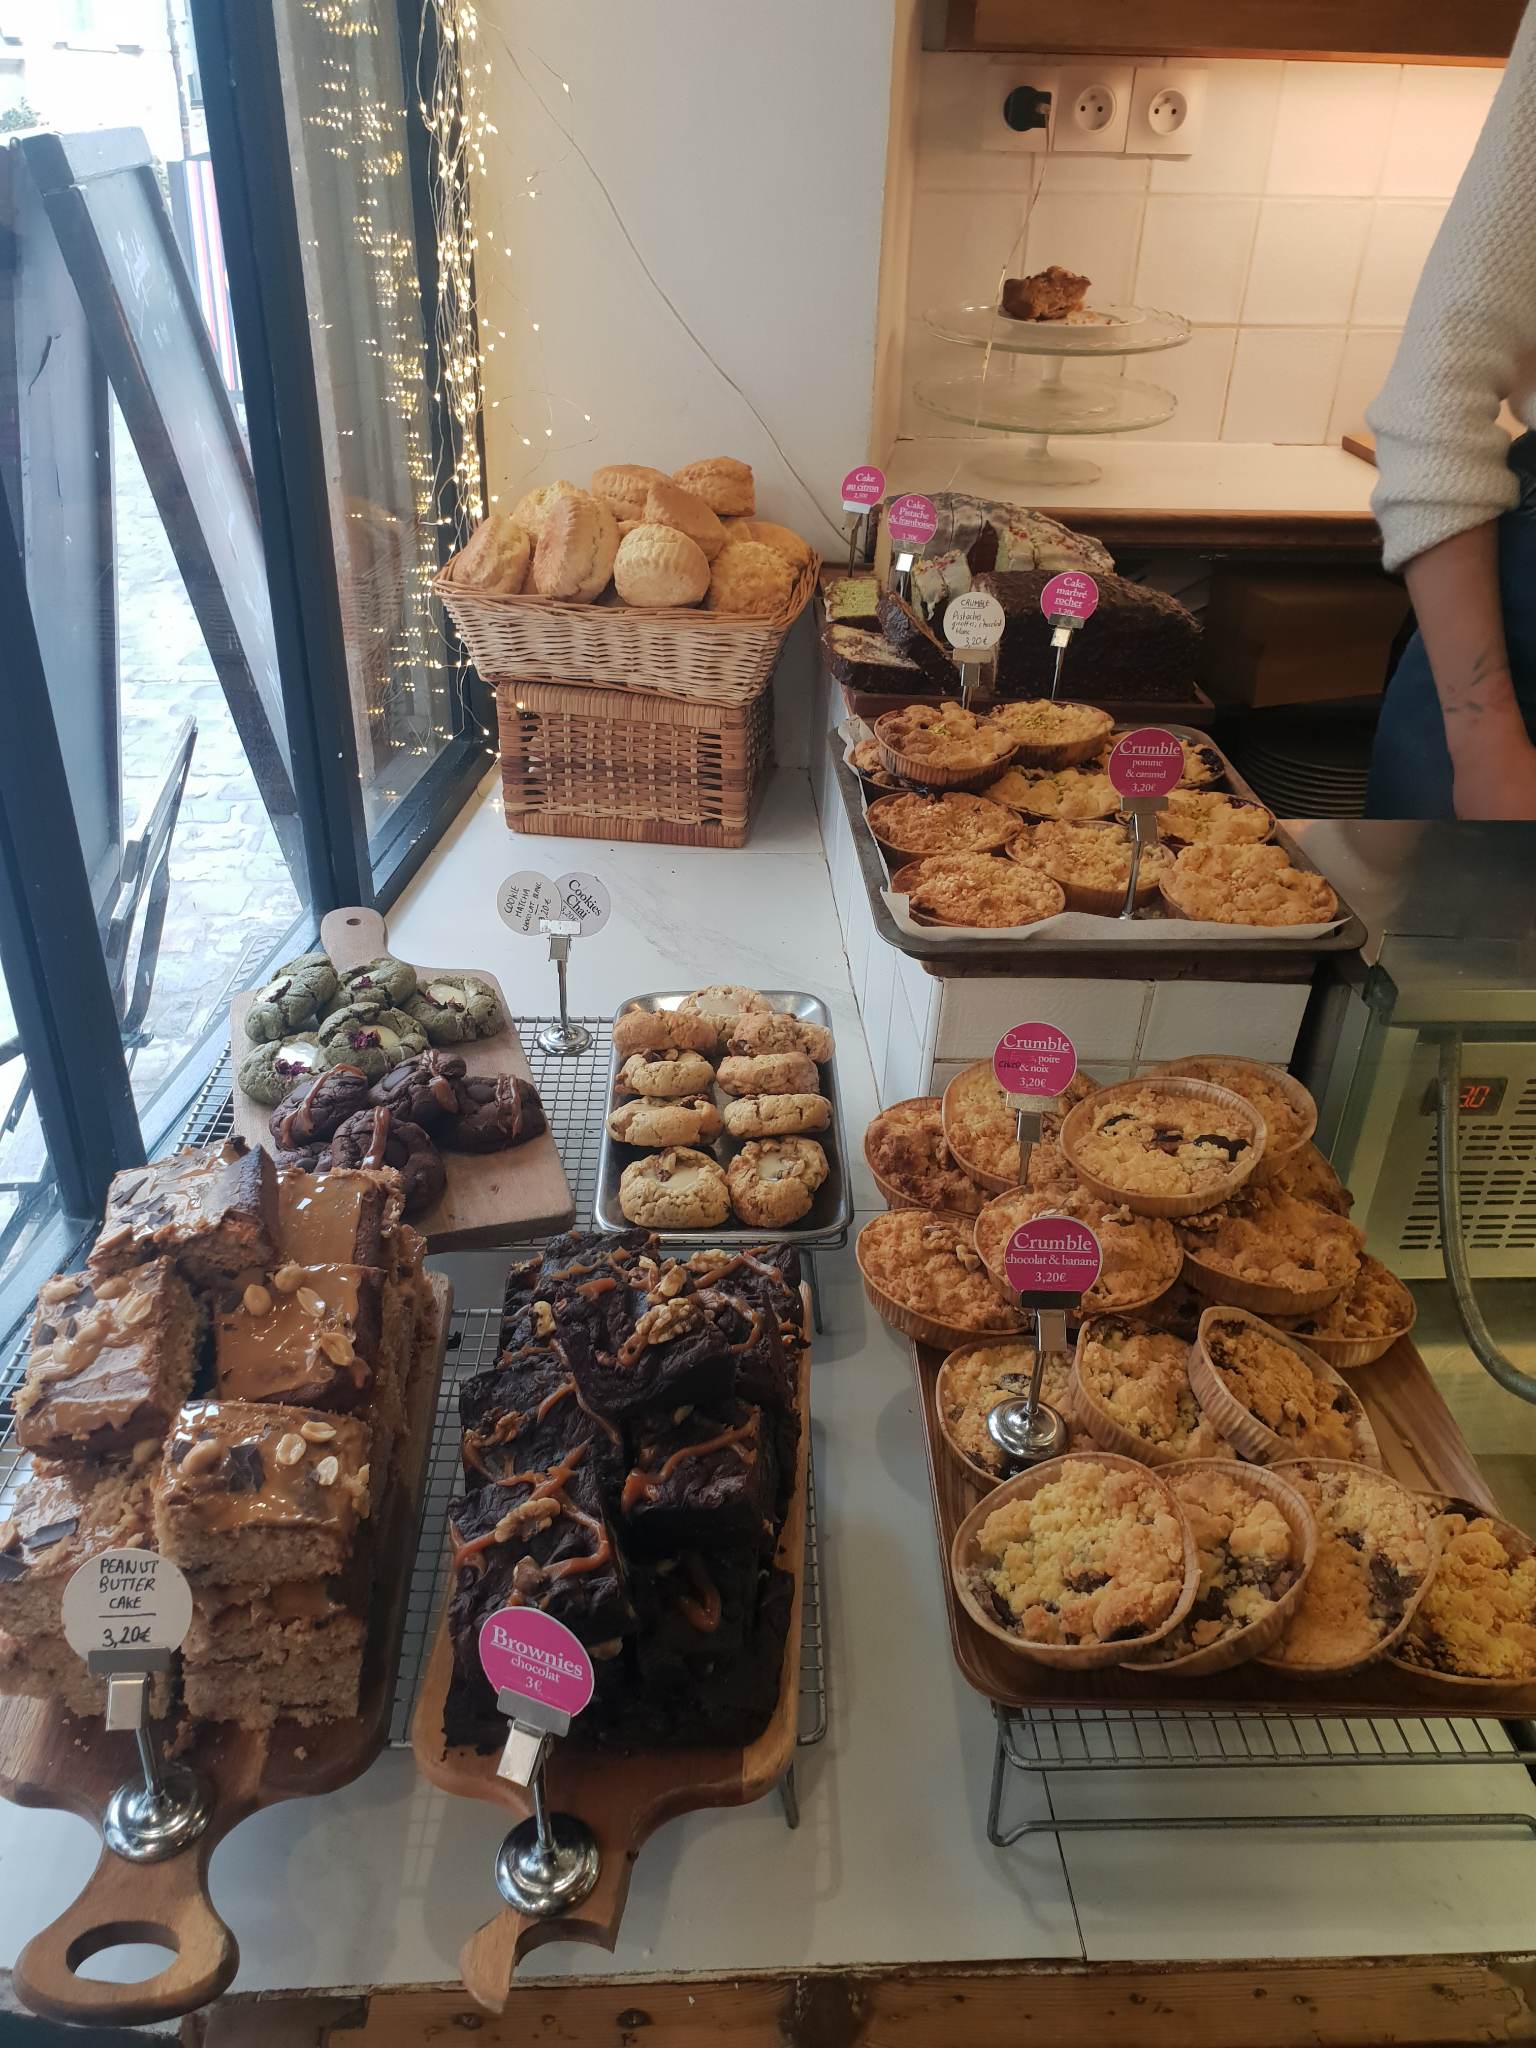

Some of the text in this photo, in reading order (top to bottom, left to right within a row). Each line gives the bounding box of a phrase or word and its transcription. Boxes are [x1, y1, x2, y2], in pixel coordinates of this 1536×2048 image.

[856, 473, 876, 483] Cake
[906, 500, 926, 510] Cake
[899, 507, 930, 519] Pistache
[889, 515, 898, 524] &
[1063, 577, 1086, 589] Cake
[1056, 587, 1088, 598] marbré
[1054, 596, 1084, 608] rocher
[1120, 741, 1180, 755] Crumble
[1132, 759, 1163, 768] pomme
[1126, 769, 1166, 779] & caramel
[1131, 783, 1156, 792] 3,20€
[504, 885, 519, 914] COOKIE
[515, 888, 531, 918] MATCHA
[568, 880, 602, 917] Cookies
[566, 894, 591, 919] Chaï
[1004, 1034, 1070, 1051] Crumble
[1038, 1055, 1060, 1065] poire
[1019, 1064, 1029, 1072] &
[1030, 1064, 1049, 1073] noix
[1020, 1077, 1047, 1088] 3,20€
[1013, 1233, 1092, 1251] Crumble
[1005, 1253, 1098, 1266] chocolat & banane
[1034, 1271, 1066, 1283] 3,20€
[100, 1558, 159, 1574] PEANUT
[99, 1575, 155, 1593] BUTTER
[109, 1596, 141, 1609] CAKE
[102, 1626, 151, 1648] 3,20€
[492, 1624, 583, 1677] Brownies
[511, 1655, 560, 1682] chocolat
